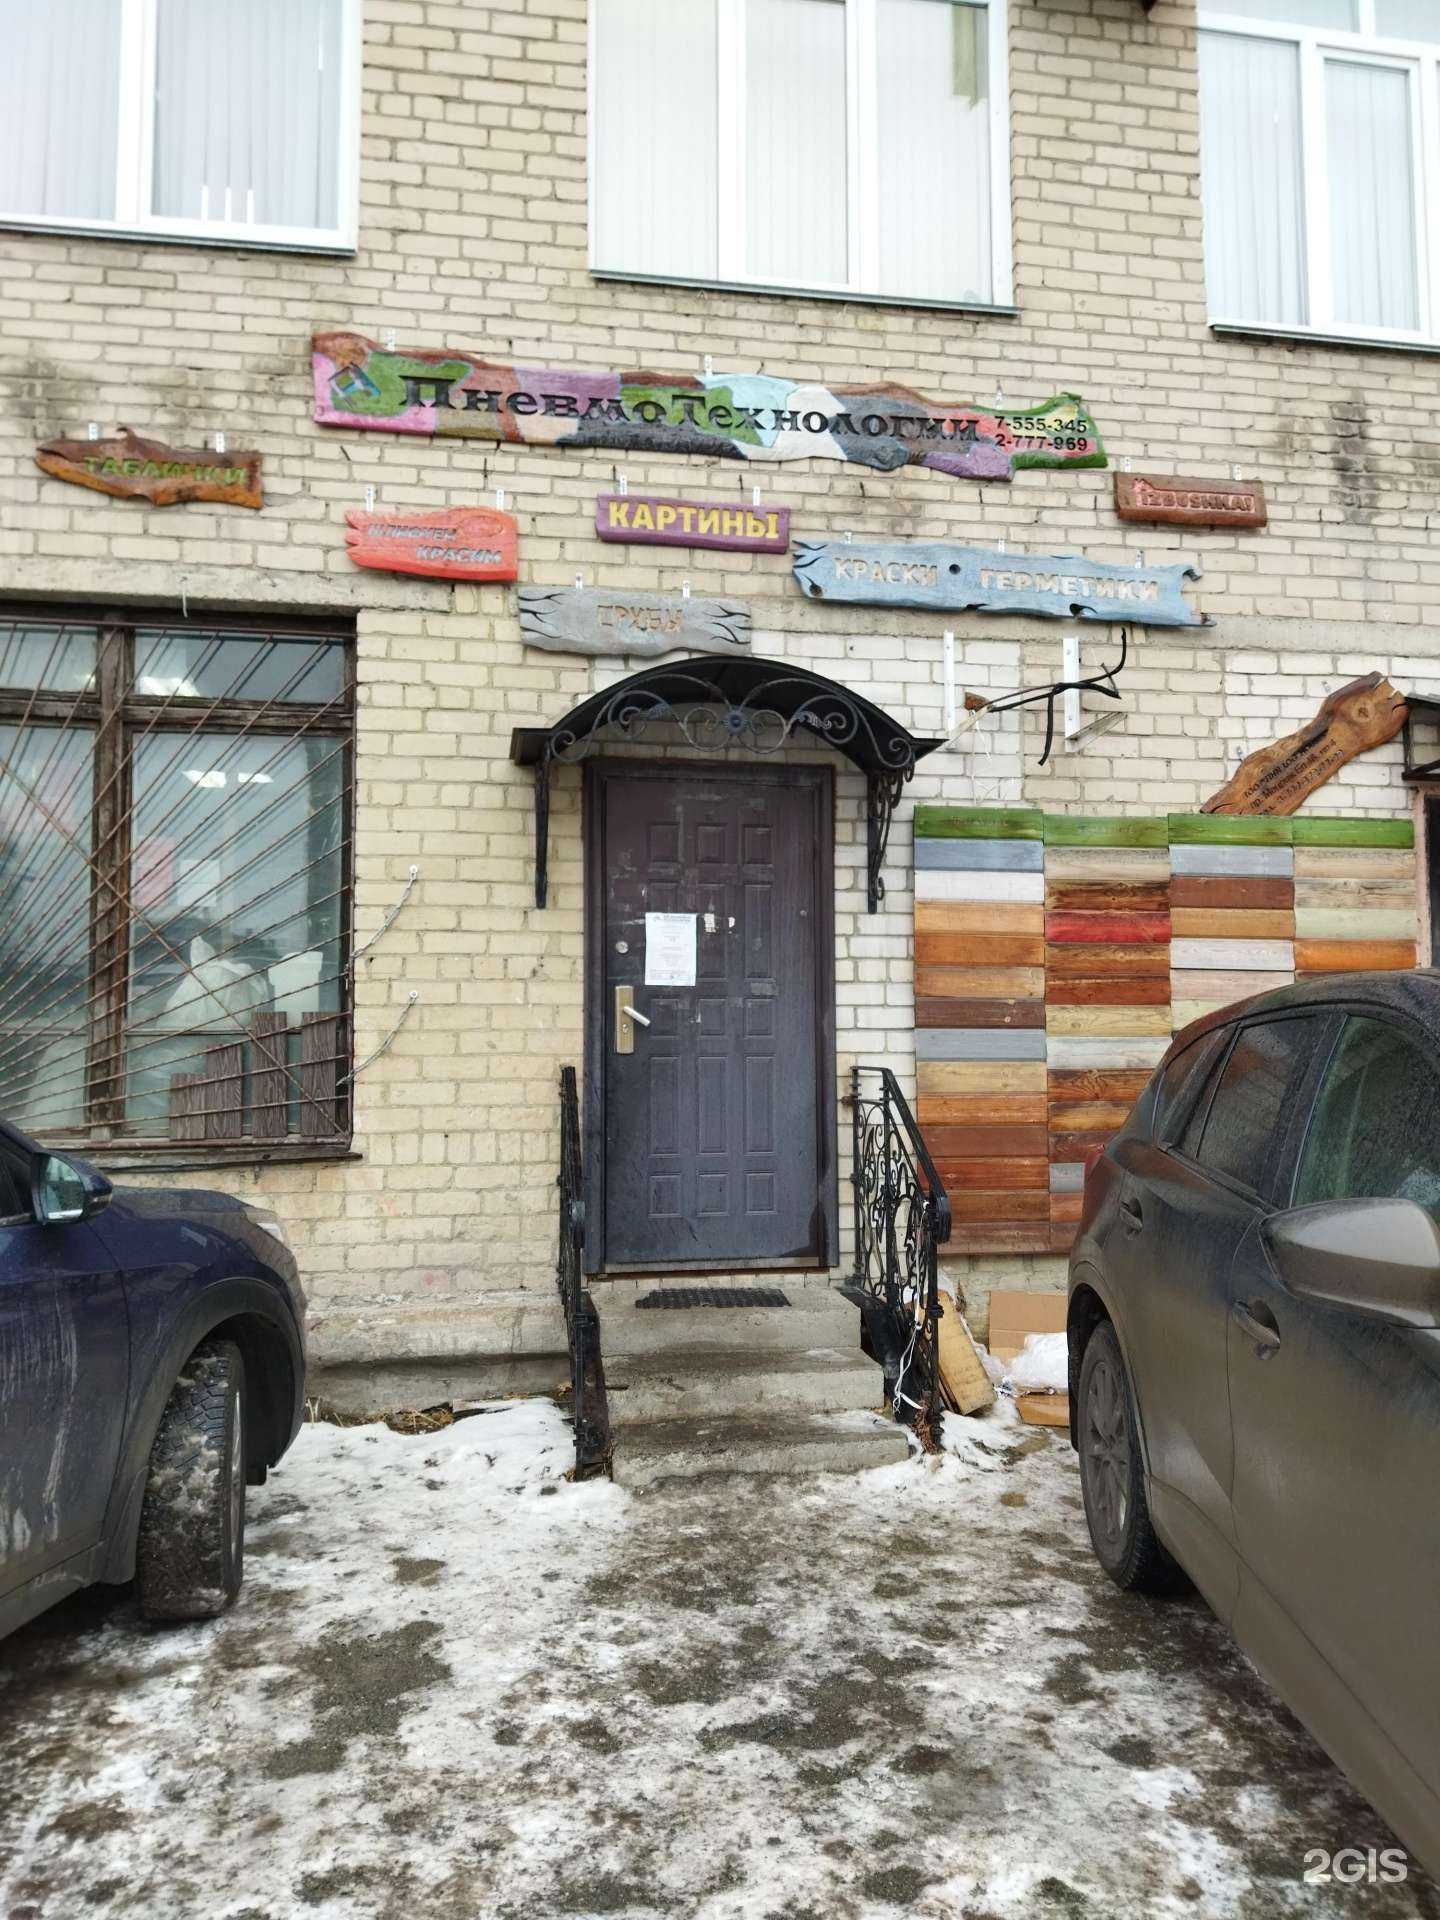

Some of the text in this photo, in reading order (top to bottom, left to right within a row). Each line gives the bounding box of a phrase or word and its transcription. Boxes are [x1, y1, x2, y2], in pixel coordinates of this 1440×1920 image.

[995, 415, 1087, 434] 7-555-345
[995, 433, 1088, 451] 2-777-969
[609, 501, 779, 540] КАРТИНЫ
[415, 544, 502, 564] КРАСИМ
[832, 557, 1159, 600] КРАСКИ ГЕРМЕТИКИ
